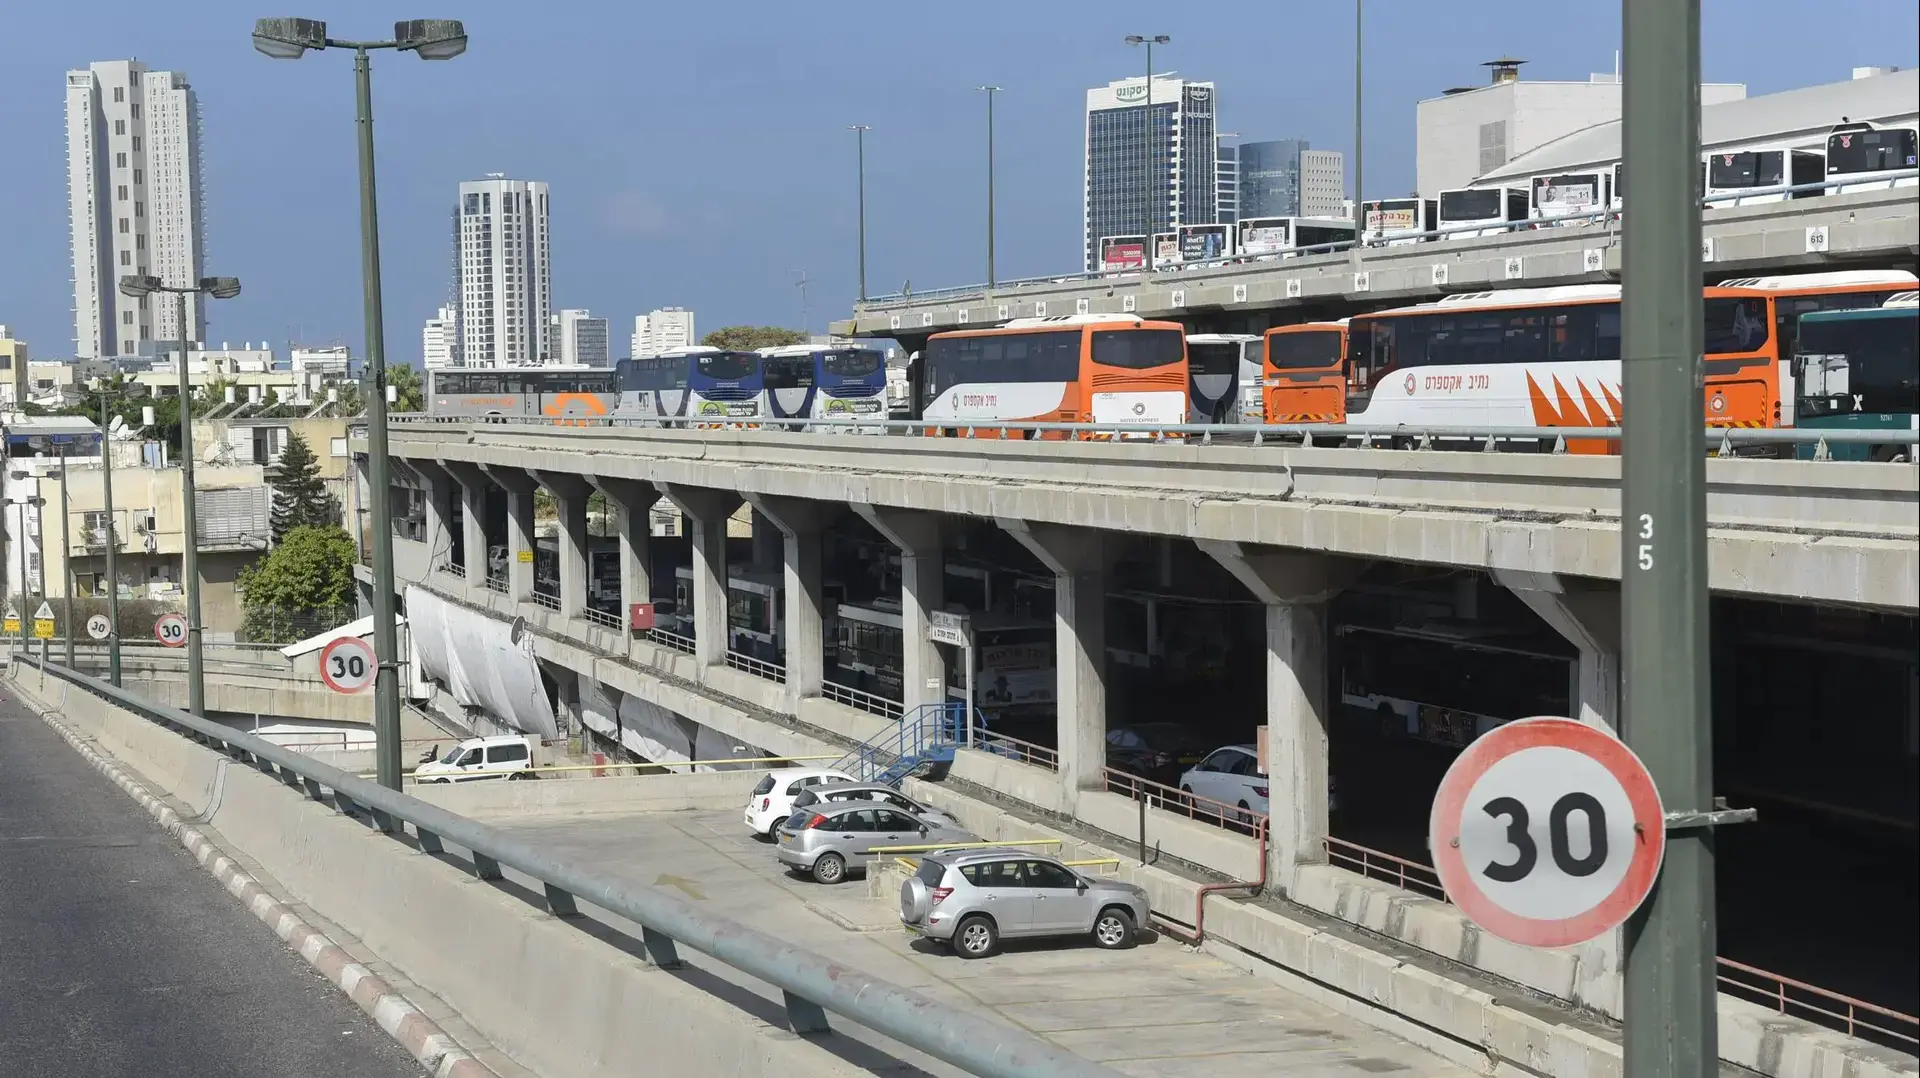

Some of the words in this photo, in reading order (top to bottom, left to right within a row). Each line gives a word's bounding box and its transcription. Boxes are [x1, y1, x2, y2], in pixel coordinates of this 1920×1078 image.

[1116, 85, 1148, 98] יסקונט
[1811, 234, 1824, 244] 613
[1587, 256, 1599, 264] 615
[1508, 264, 1519, 272] 616
[1425, 375, 1462, 394] אקספרס
[1468, 375, 1489, 389] נתיב
[91, 621, 105, 633] 30
[162, 625, 181, 638] 30
[332, 655, 364, 678] 30
[1482, 791, 1608, 883] 30
